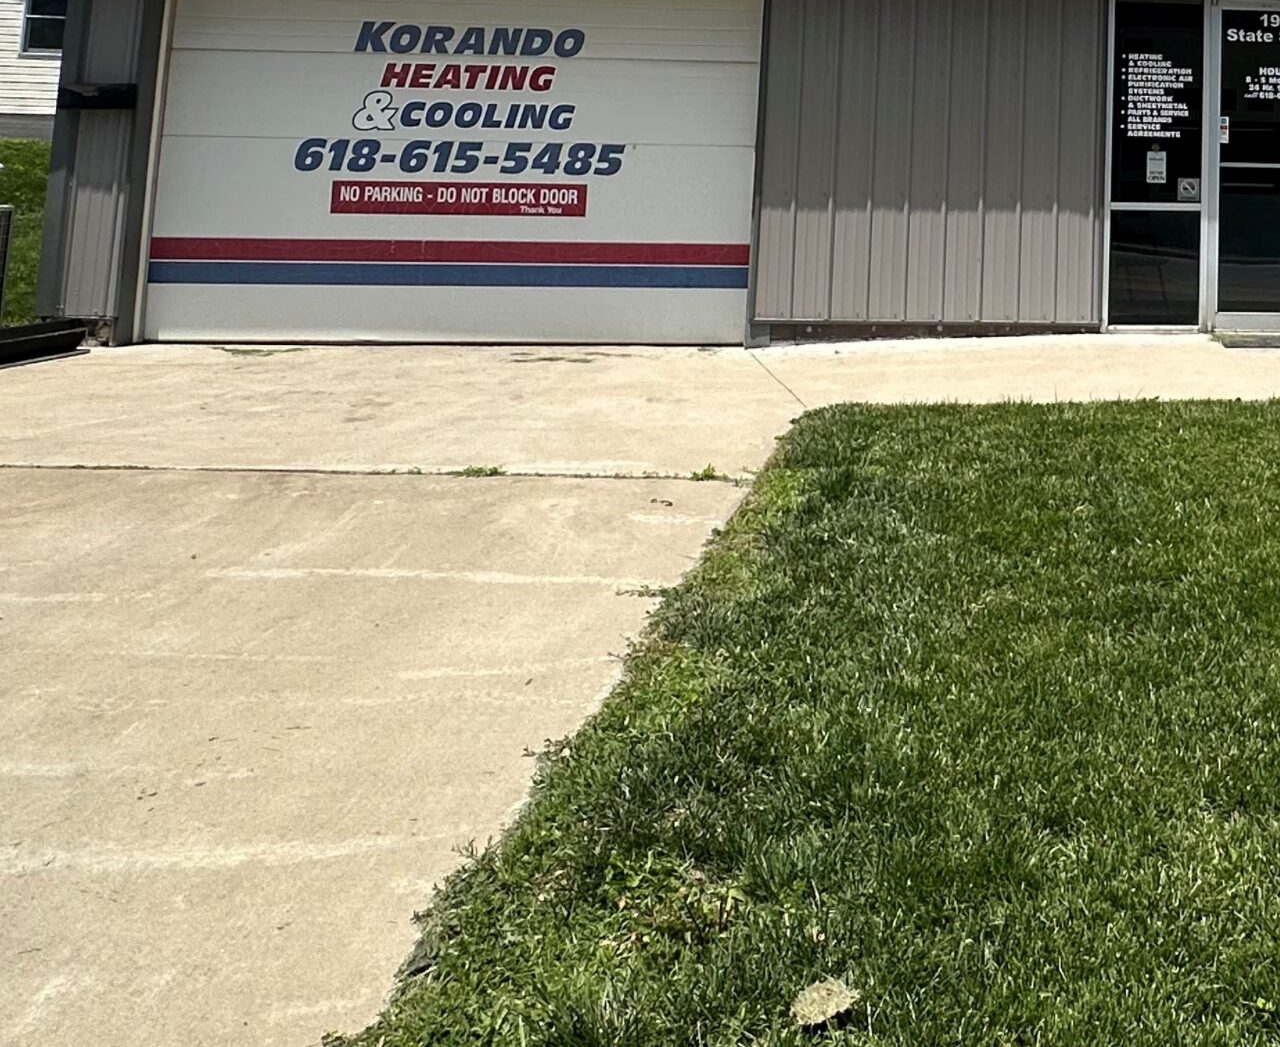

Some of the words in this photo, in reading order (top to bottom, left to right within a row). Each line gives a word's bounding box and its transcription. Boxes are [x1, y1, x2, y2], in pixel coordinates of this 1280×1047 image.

[354, 21, 585, 58] KORANDO
[1226, 28, 1274, 43] State
[380, 63, 556, 91] HEATING
[1127, 81, 1184, 89] PURIFICATION
[352, 90, 399, 130] &
[400, 101, 576, 130] COOLING
[294, 138, 626, 176] 618-615-5485
[340, 186, 360, 202] NO
[364, 186, 423, 202] PARKING
[437, 187, 457, 203] DO
[461, 187, 489, 204] NOT
[492, 188, 536, 204] BLOCK
[540, 188, 578, 205] DOOR
[520, 205, 545, 214] Thank
[547, 206, 562, 214] You
